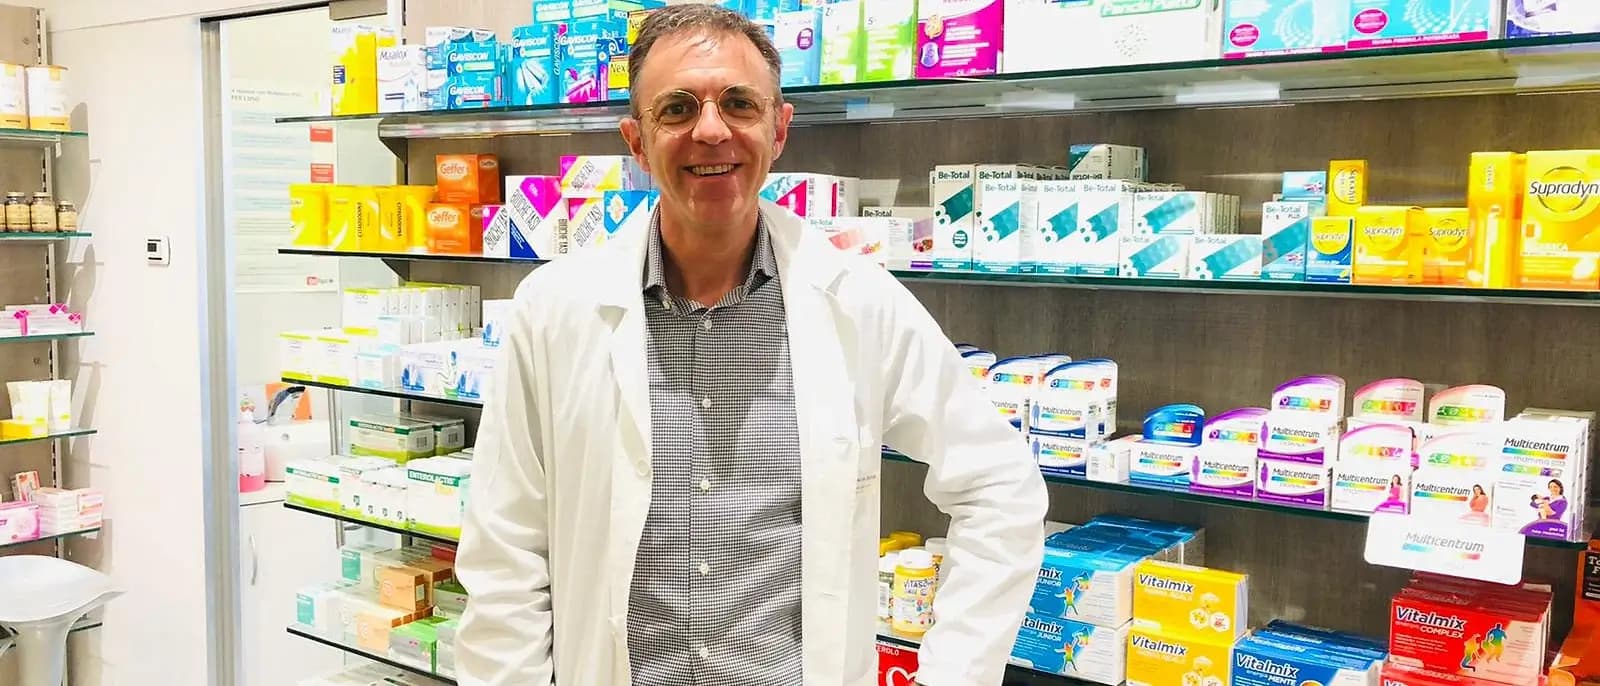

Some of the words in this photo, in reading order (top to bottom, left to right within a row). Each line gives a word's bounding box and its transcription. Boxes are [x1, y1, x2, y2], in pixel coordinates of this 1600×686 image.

[439, 163, 465, 175] Geffer
[938, 170, 970, 179] Be-Total
[979, 170, 1012, 179] Be-Total
[985, 183, 1017, 192] Be-Total
[1043, 184, 1076, 193] Be-Total
[1083, 184, 1117, 192] Be-Total
[1528, 179, 1600, 198] Supradyn
[430, 211, 457, 225] Geffer
[1364, 225, 1403, 237] Supradyn
[1041, 405, 1083, 416] Multicentrum
[1273, 426, 1320, 438] Multicentrum
[1041, 442, 1083, 453] Multicentrum
[1505, 437, 1570, 453] Multicentrum
[1140, 450, 1183, 462] Multicentrum
[1204, 460, 1250, 472] Multicentrum
[1273, 467, 1320, 479] Multicentrum
[1337, 472, 1389, 485] Multicentrum
[1416, 482, 1471, 496] Multicentrum
[1405, 531, 1485, 553] Multicentrum
[1138, 573, 1195, 594] Vitalmix
[1395, 606, 1467, 631] Vitalmix
[1420, 625, 1465, 639] COMPLEX
[1131, 634, 1188, 656] Vitalmix
[1236, 652, 1299, 679] Vitalmix
[1267, 674, 1297, 686] MENTE
